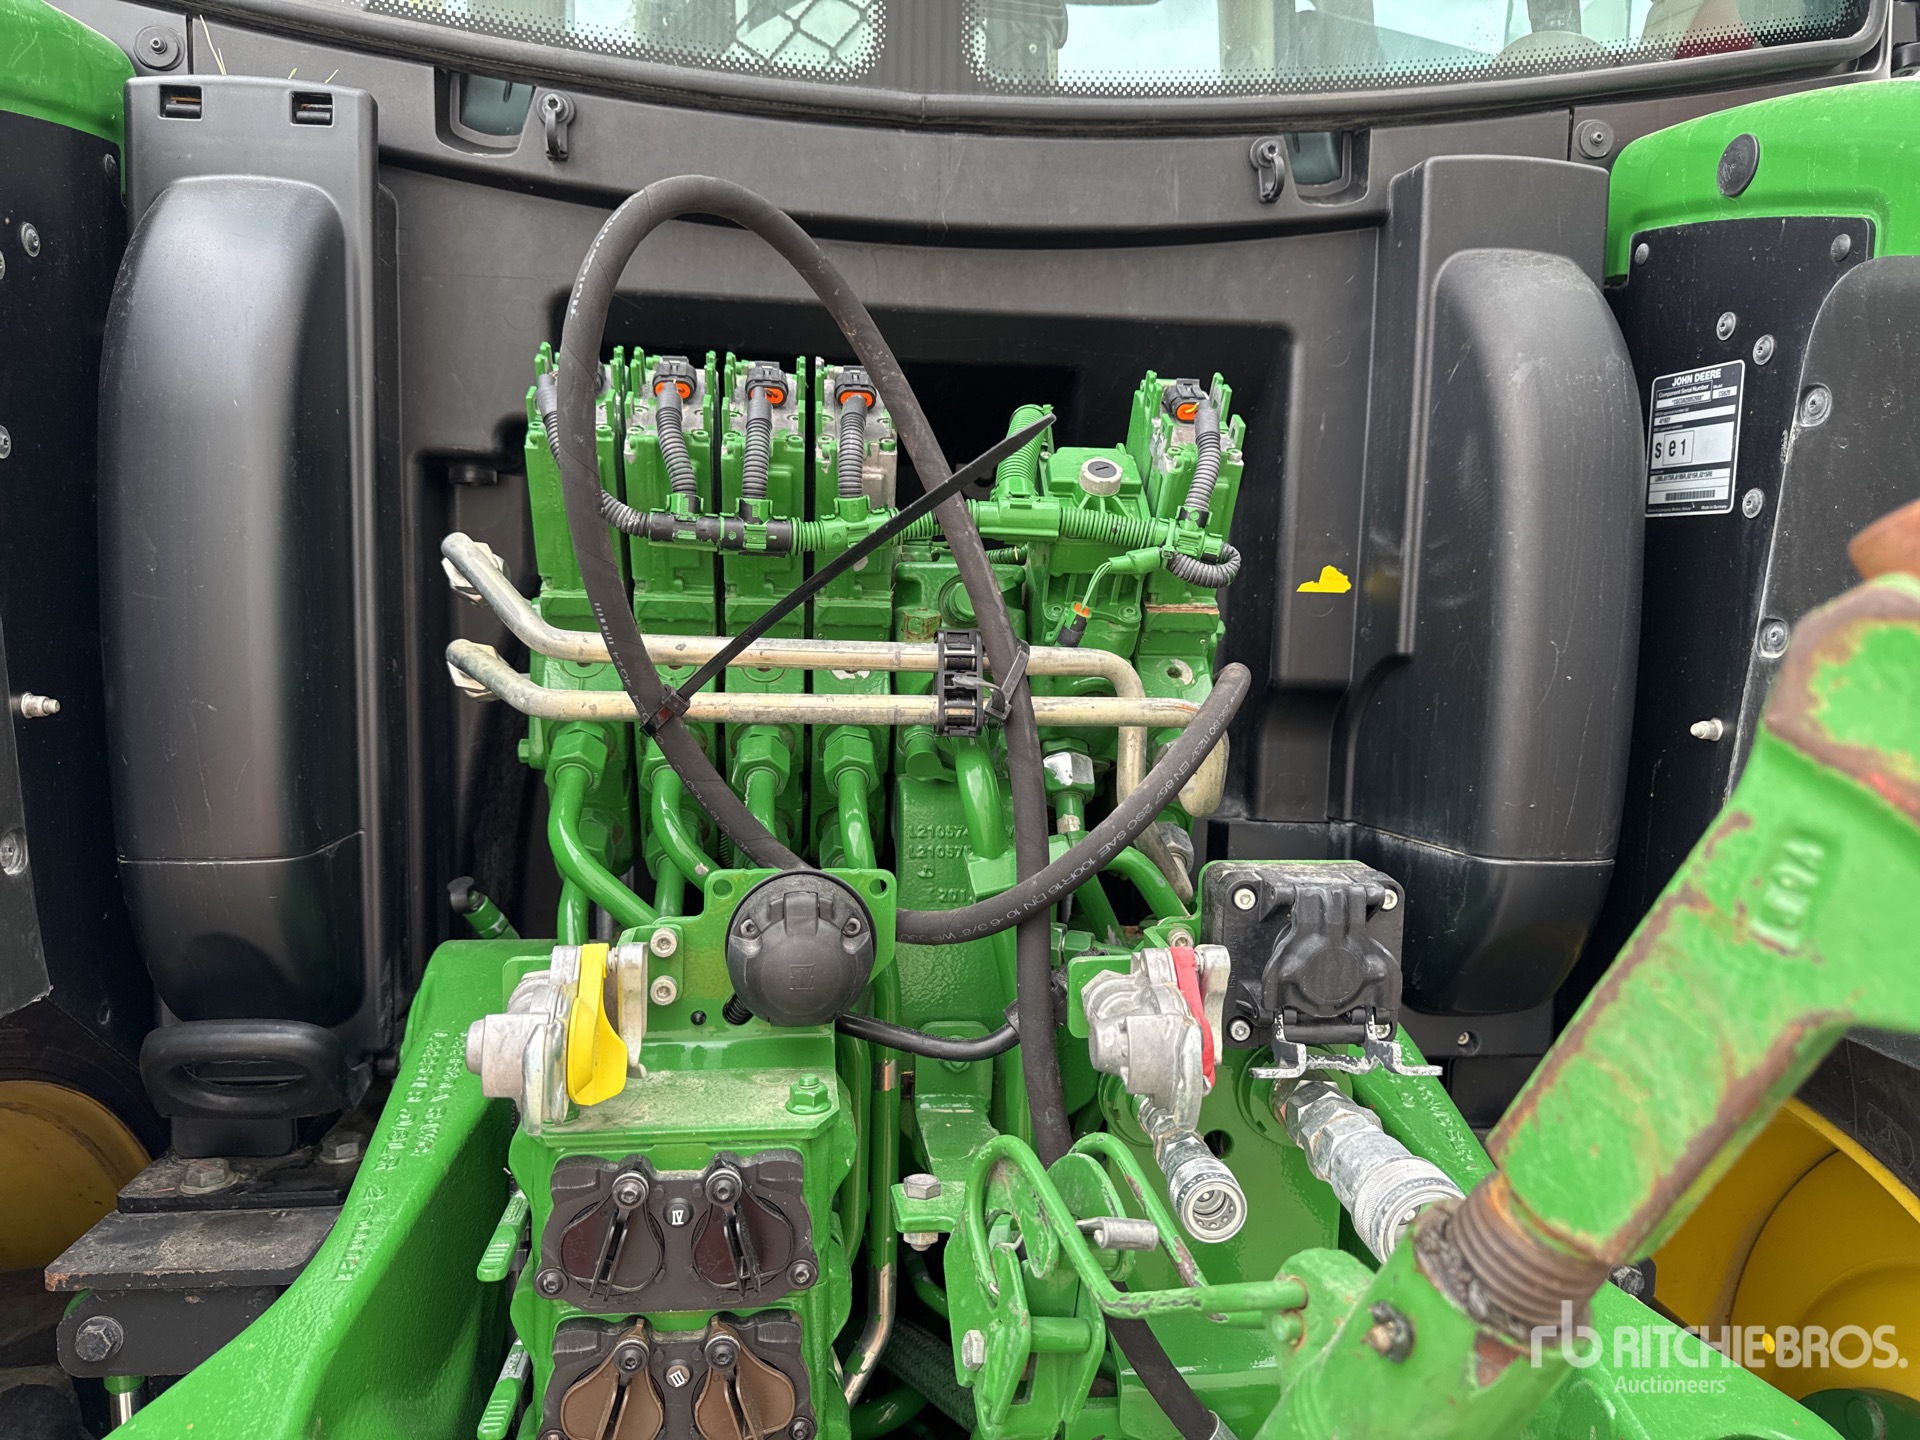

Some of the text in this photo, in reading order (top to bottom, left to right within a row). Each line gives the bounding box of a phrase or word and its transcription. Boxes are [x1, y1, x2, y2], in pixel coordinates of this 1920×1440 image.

[1672, 368, 1722, 387] JOHN DEERE
[1692, 384, 1709, 392] Number
[1219, 703, 1231, 722] 2SC
[1209, 719, 1221, 736] ISO
[1191, 734, 1211, 763] 11237
[1173, 760, 1190, 781] EN
[1155, 779, 1175, 805] 857
[1127, 802, 1153, 830] 2SC
[1096, 830, 1127, 858] SAE
[1048, 857, 1097, 895] 100R16
[1023, 892, 1048, 911] DN
[1006, 908, 1022, 919] 10
[671, 1209, 685, 1226] IV
